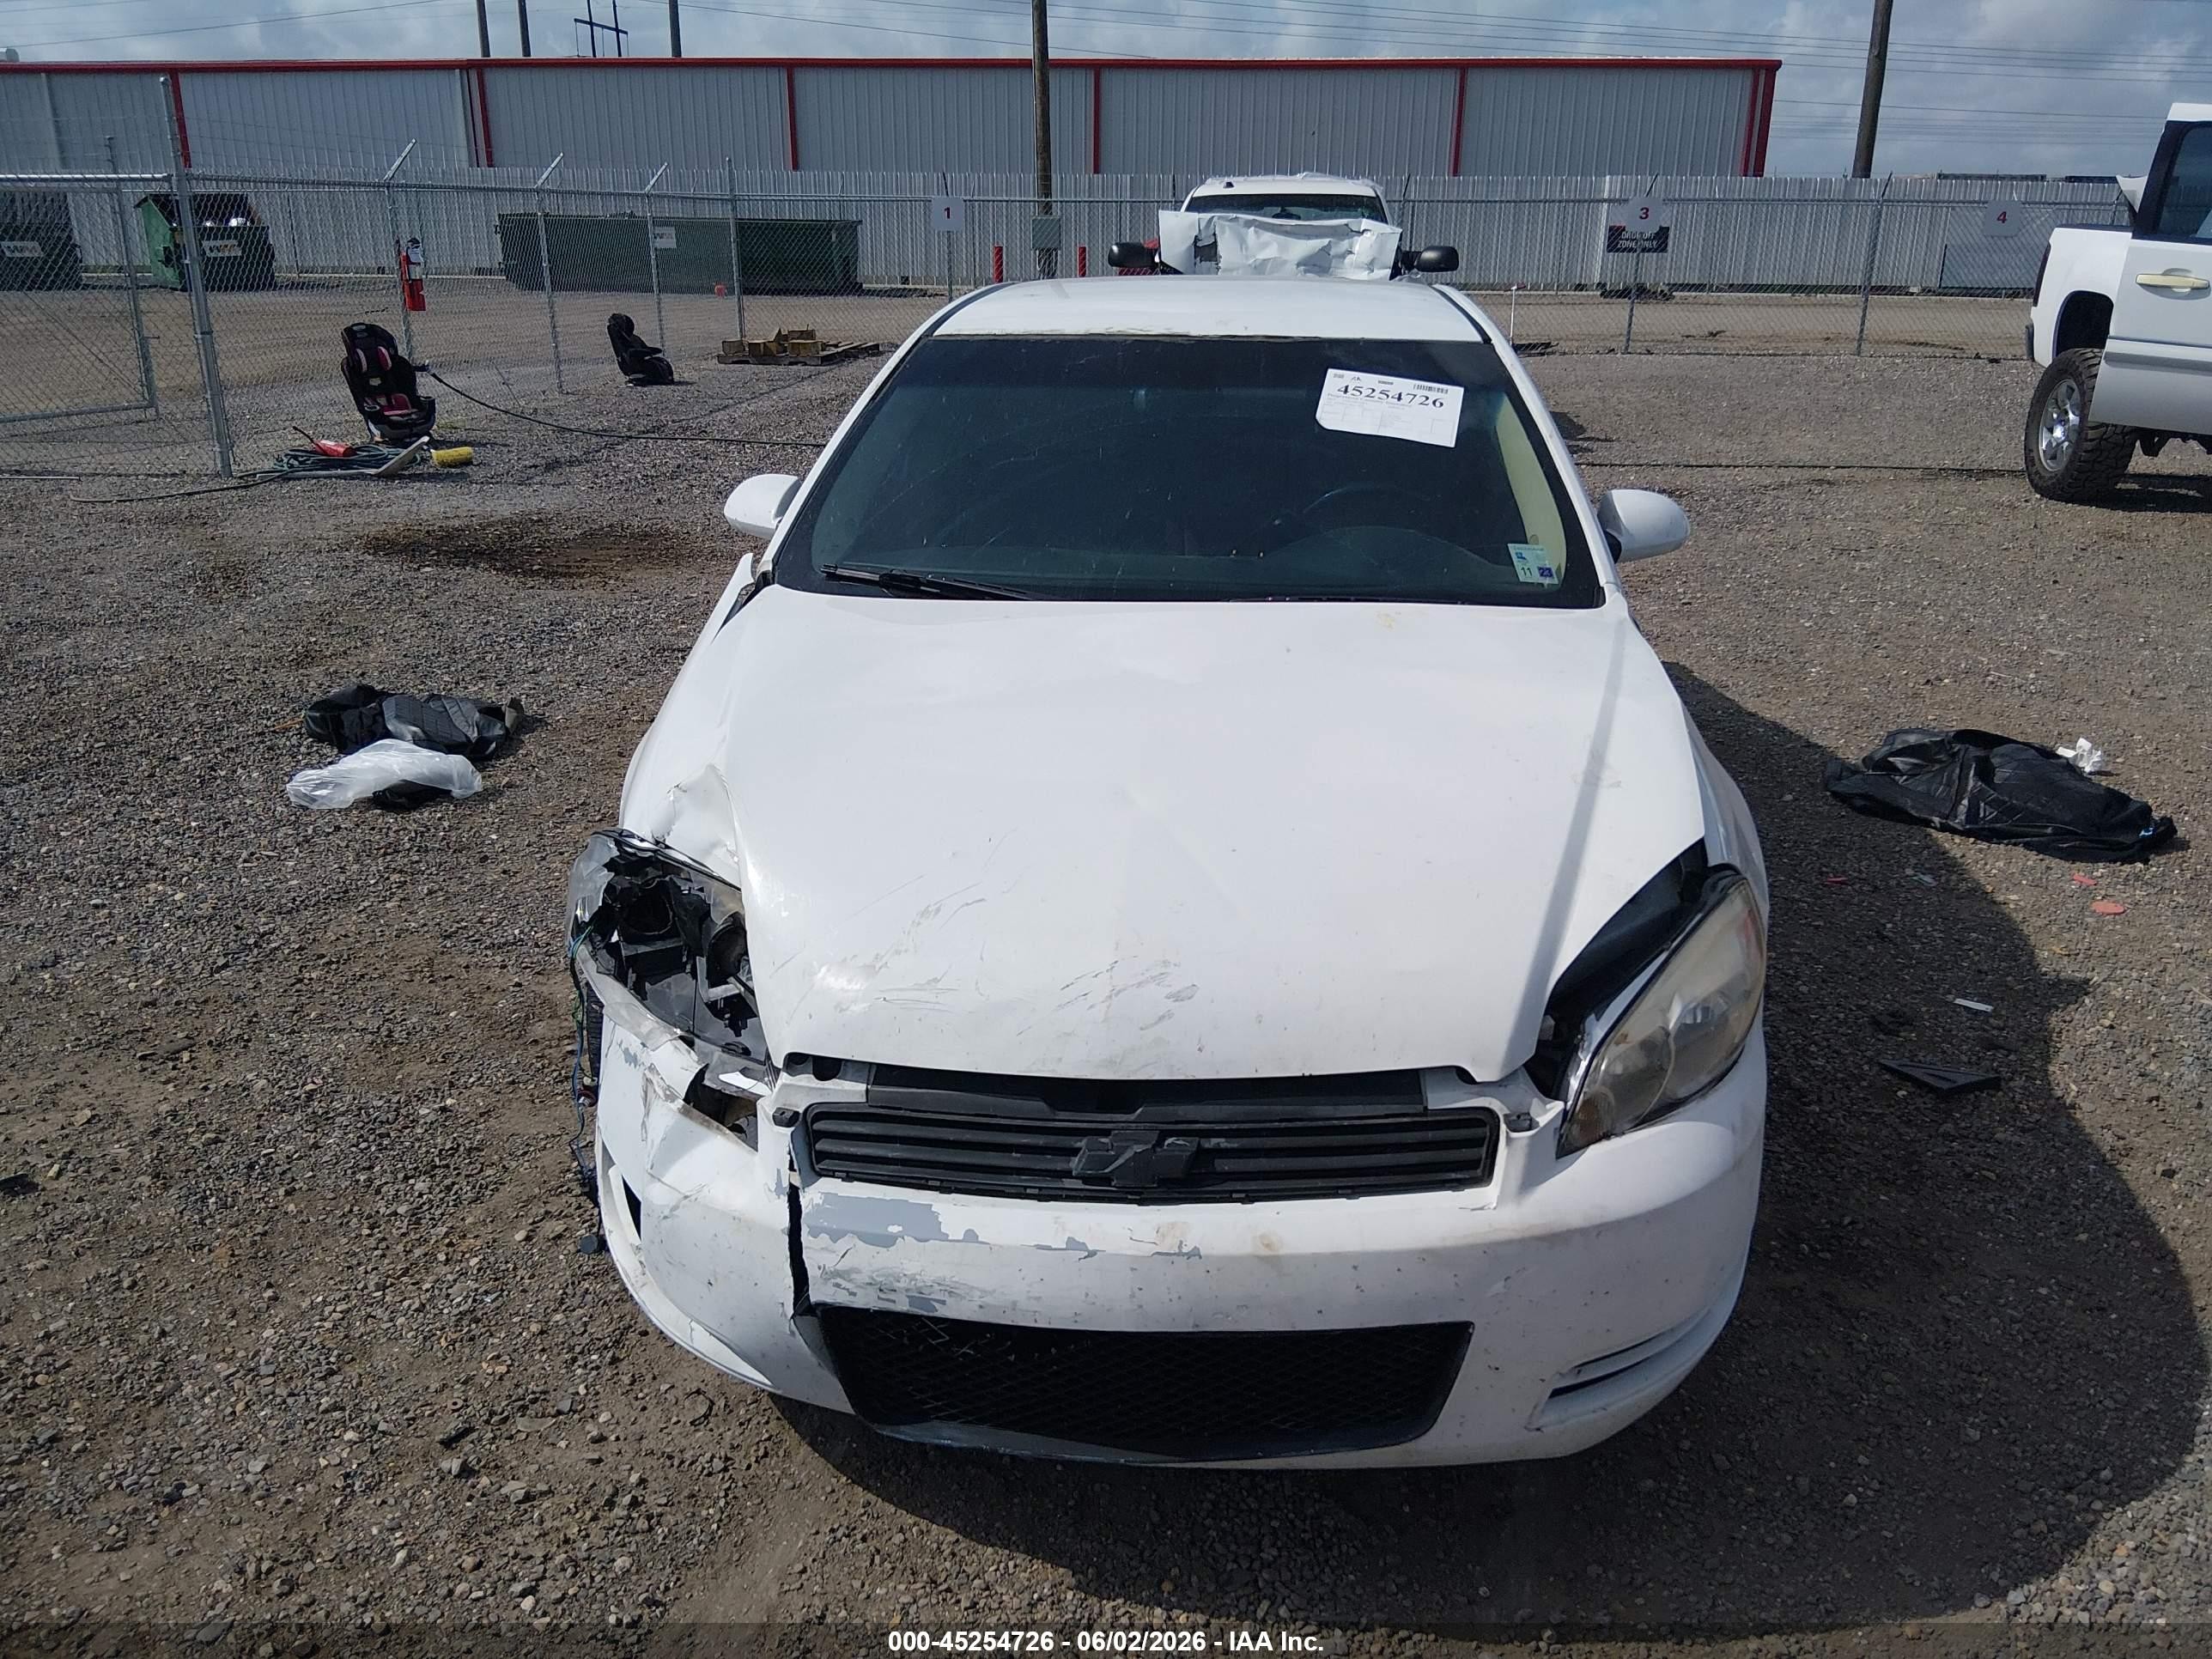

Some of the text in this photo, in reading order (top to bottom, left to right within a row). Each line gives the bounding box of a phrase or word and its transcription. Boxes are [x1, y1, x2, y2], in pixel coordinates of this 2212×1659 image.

[944, 206, 951, 220] 1
[1638, 206, 1650, 220] 3
[1996, 210, 2007, 224] 4
[1337, 384, 1444, 408] 45254726
[1520, 567, 1533, 577] 11
